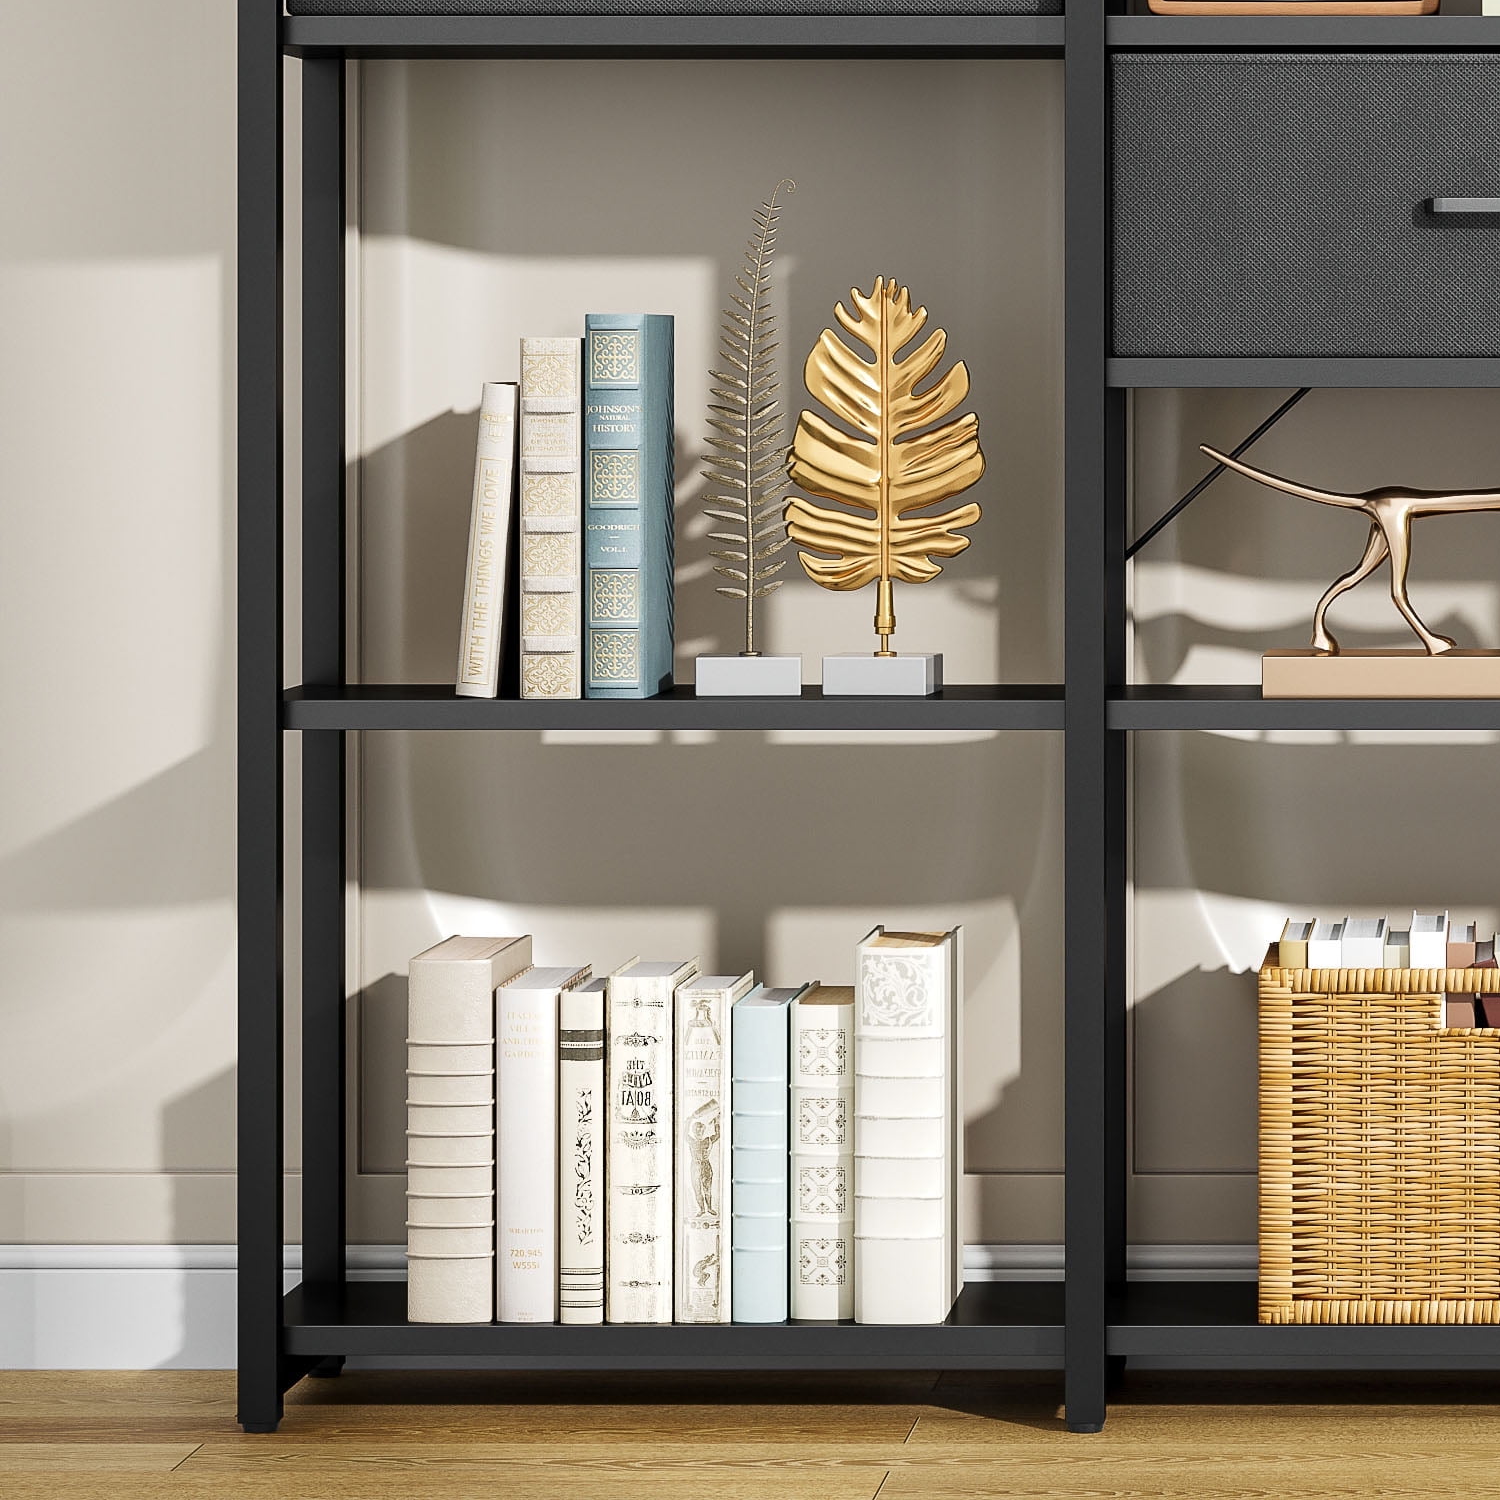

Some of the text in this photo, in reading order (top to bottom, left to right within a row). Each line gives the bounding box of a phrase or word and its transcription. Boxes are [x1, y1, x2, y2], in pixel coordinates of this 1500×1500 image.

[586, 404, 641, 415] JOHNSON'S
[592, 423, 637, 432] HISTORY
[467, 468, 500, 676] WITH THE THINGS WE LOVE
